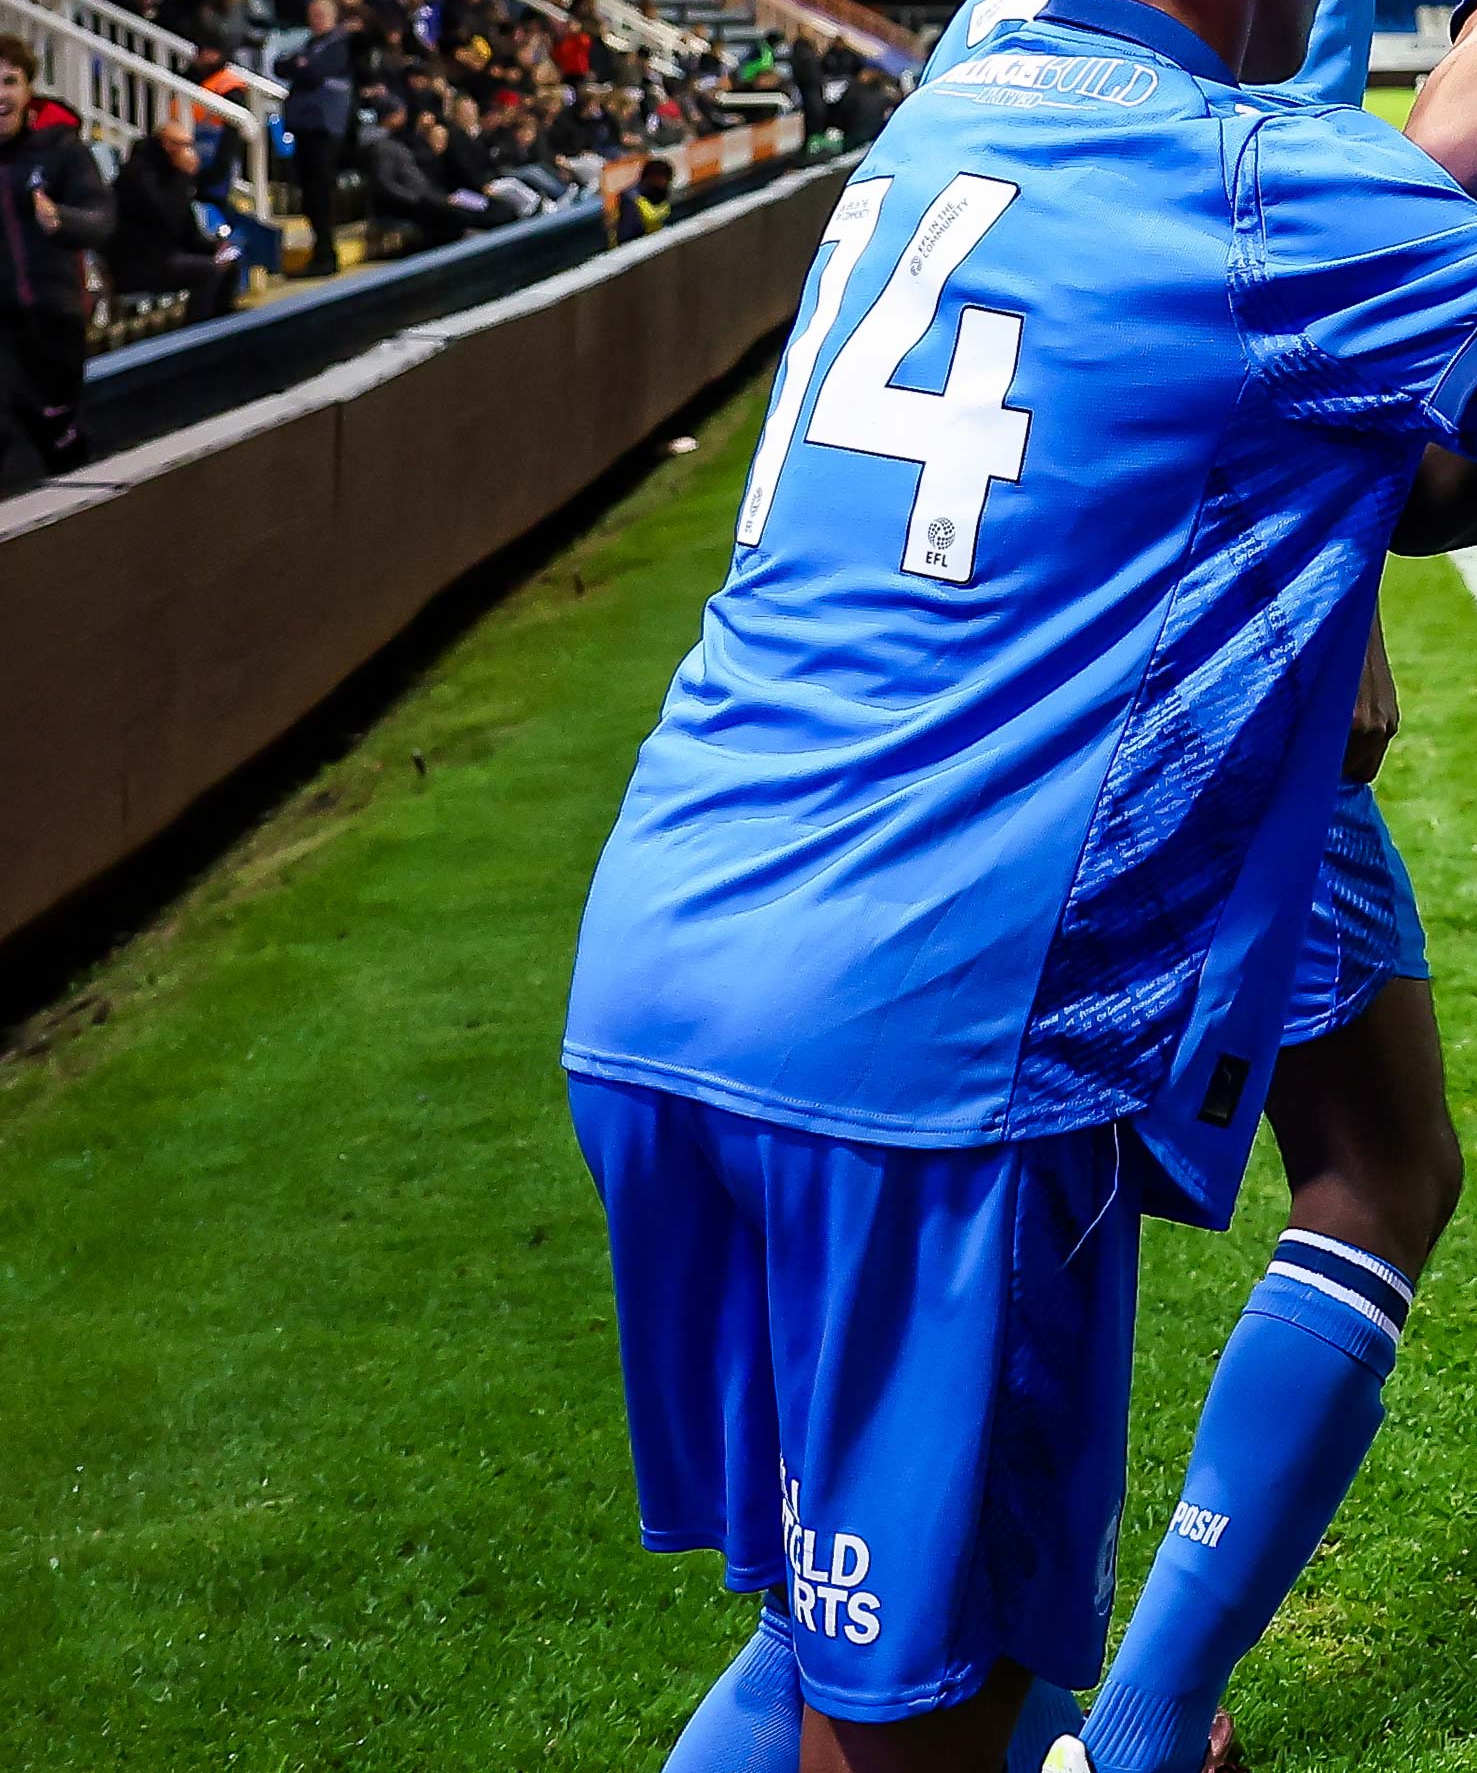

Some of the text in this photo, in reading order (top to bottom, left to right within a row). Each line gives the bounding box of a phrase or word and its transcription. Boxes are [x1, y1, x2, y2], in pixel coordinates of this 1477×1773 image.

[922, 197, 969, 259] COMMUNITY
[937, 201, 957, 222] THE
[736, 172, 1032, 585] 14
[925, 551, 949, 568] EFL
[1169, 1500, 1231, 1548] POSH
